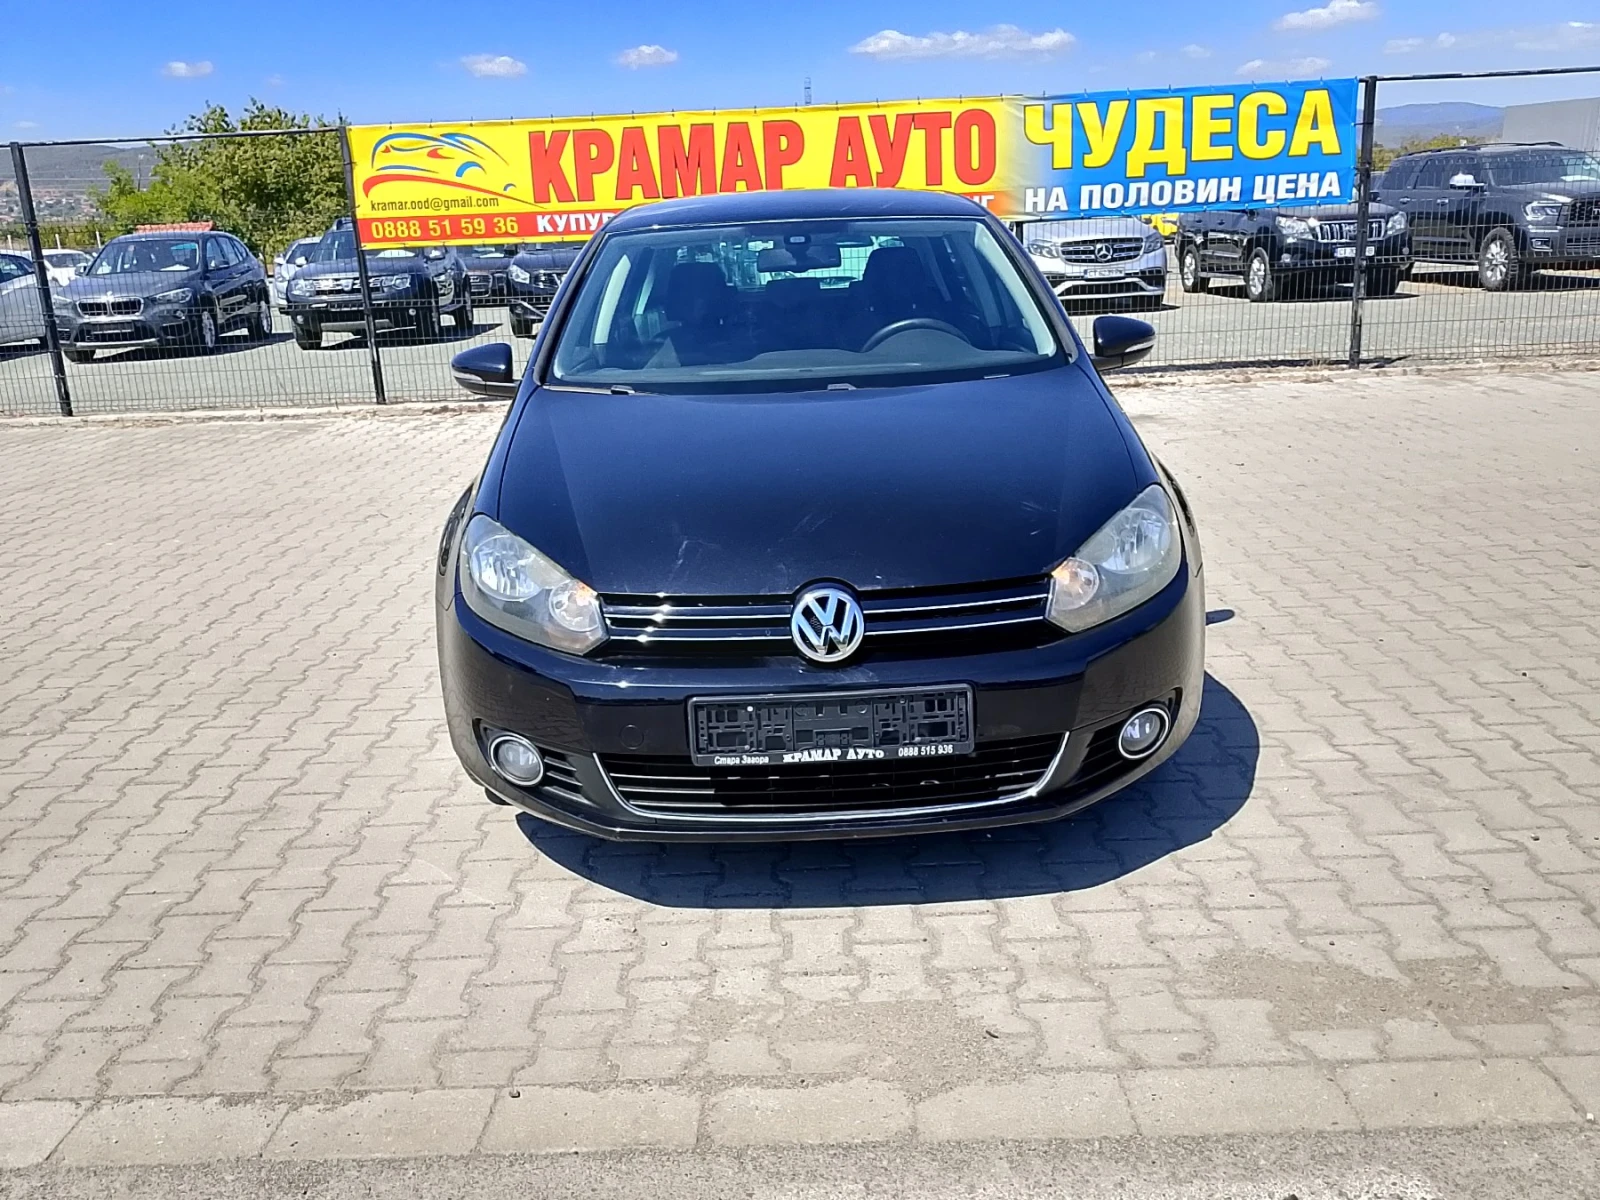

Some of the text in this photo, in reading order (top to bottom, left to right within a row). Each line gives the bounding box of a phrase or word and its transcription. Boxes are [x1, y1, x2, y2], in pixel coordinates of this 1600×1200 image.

[1023, 89, 1342, 178] ЧУДЕСА
[528, 108, 997, 204] КРАМАР АУТО
[371, 196, 500, 211] kramar.ood@gmail.com
[1025, 187, 1069, 213] НА
[1080, 176, 1241, 210] ПОЛОВИН
[1253, 171, 1341, 203] ЦЕНА
[371, 216, 519, 239] 0888 51 59 36
[783, 747, 842, 763] КРАМАР
[898, 746, 918, 757] 0888
[920, 745, 936, 756] 515
